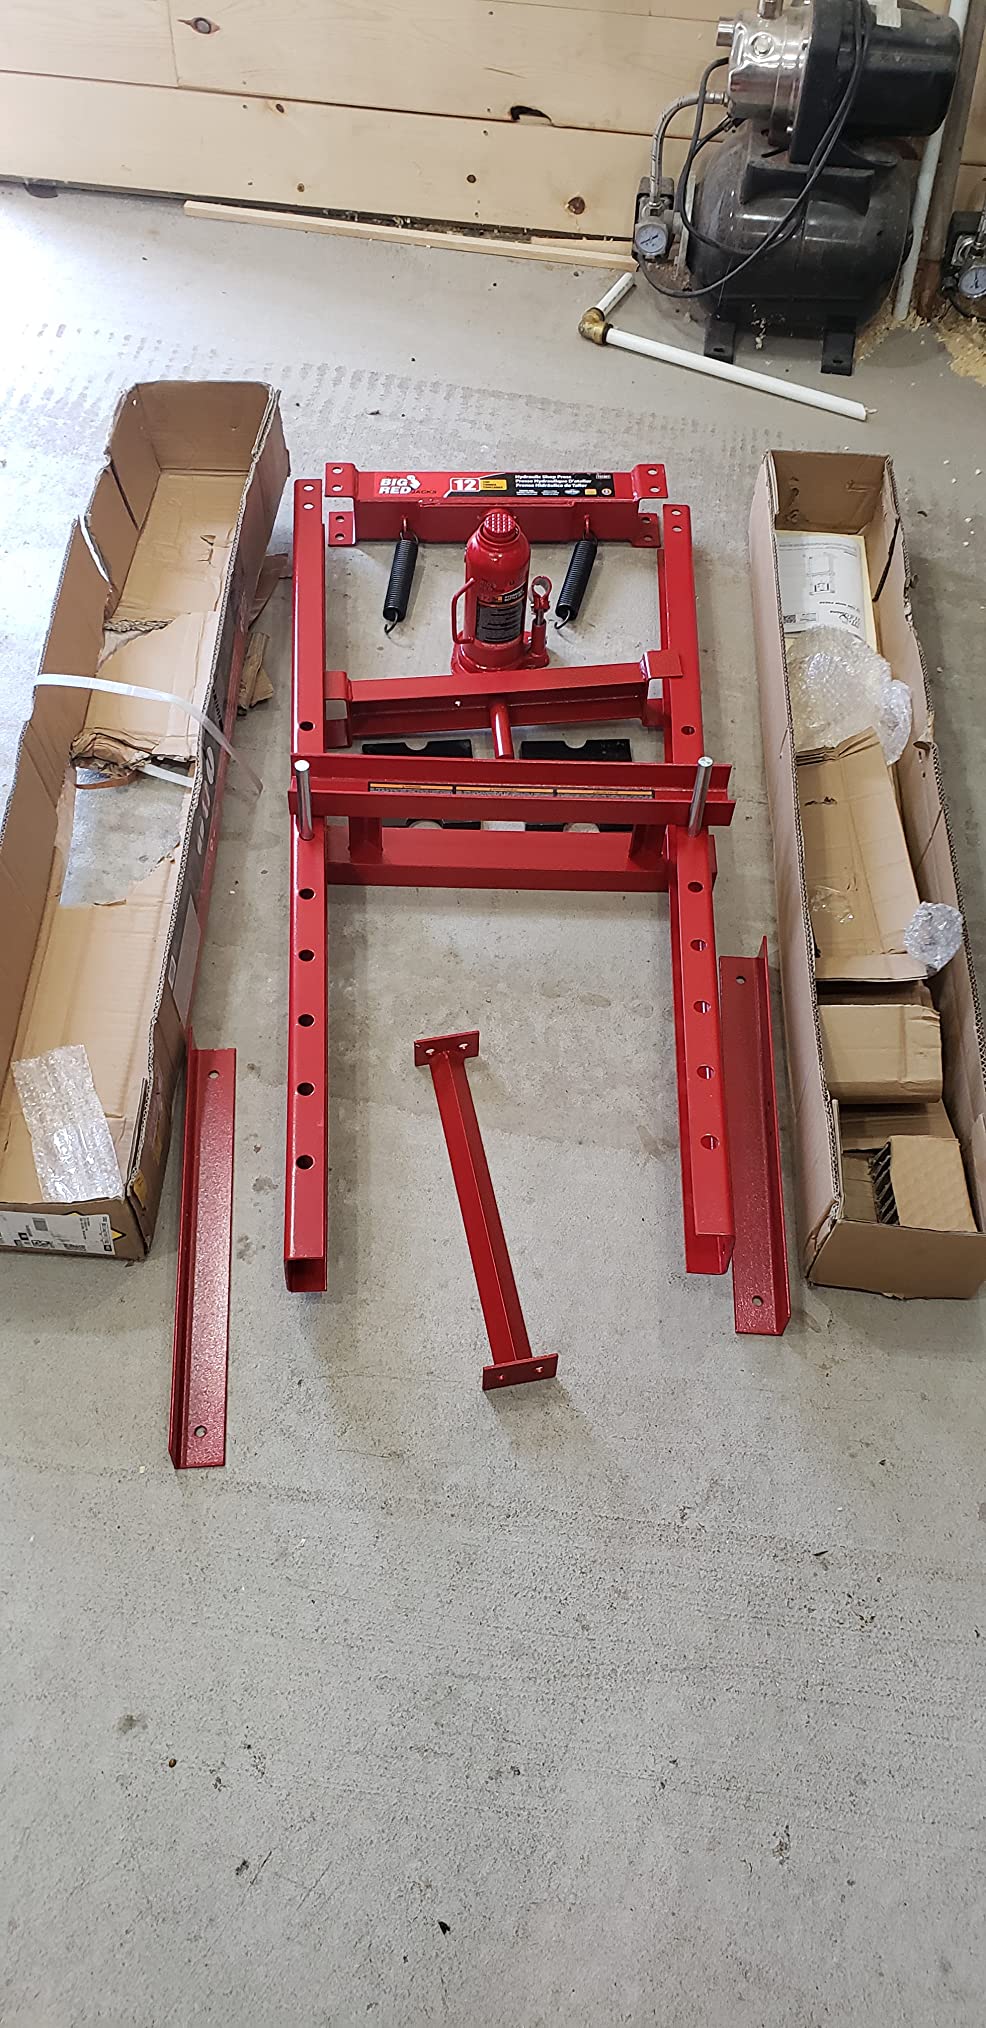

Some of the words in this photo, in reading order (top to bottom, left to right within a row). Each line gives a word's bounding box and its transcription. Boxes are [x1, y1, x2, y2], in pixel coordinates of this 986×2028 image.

[380, 478, 409, 486] BIG
[453, 479, 477, 491] 12
[379, 486, 412, 494] RED
